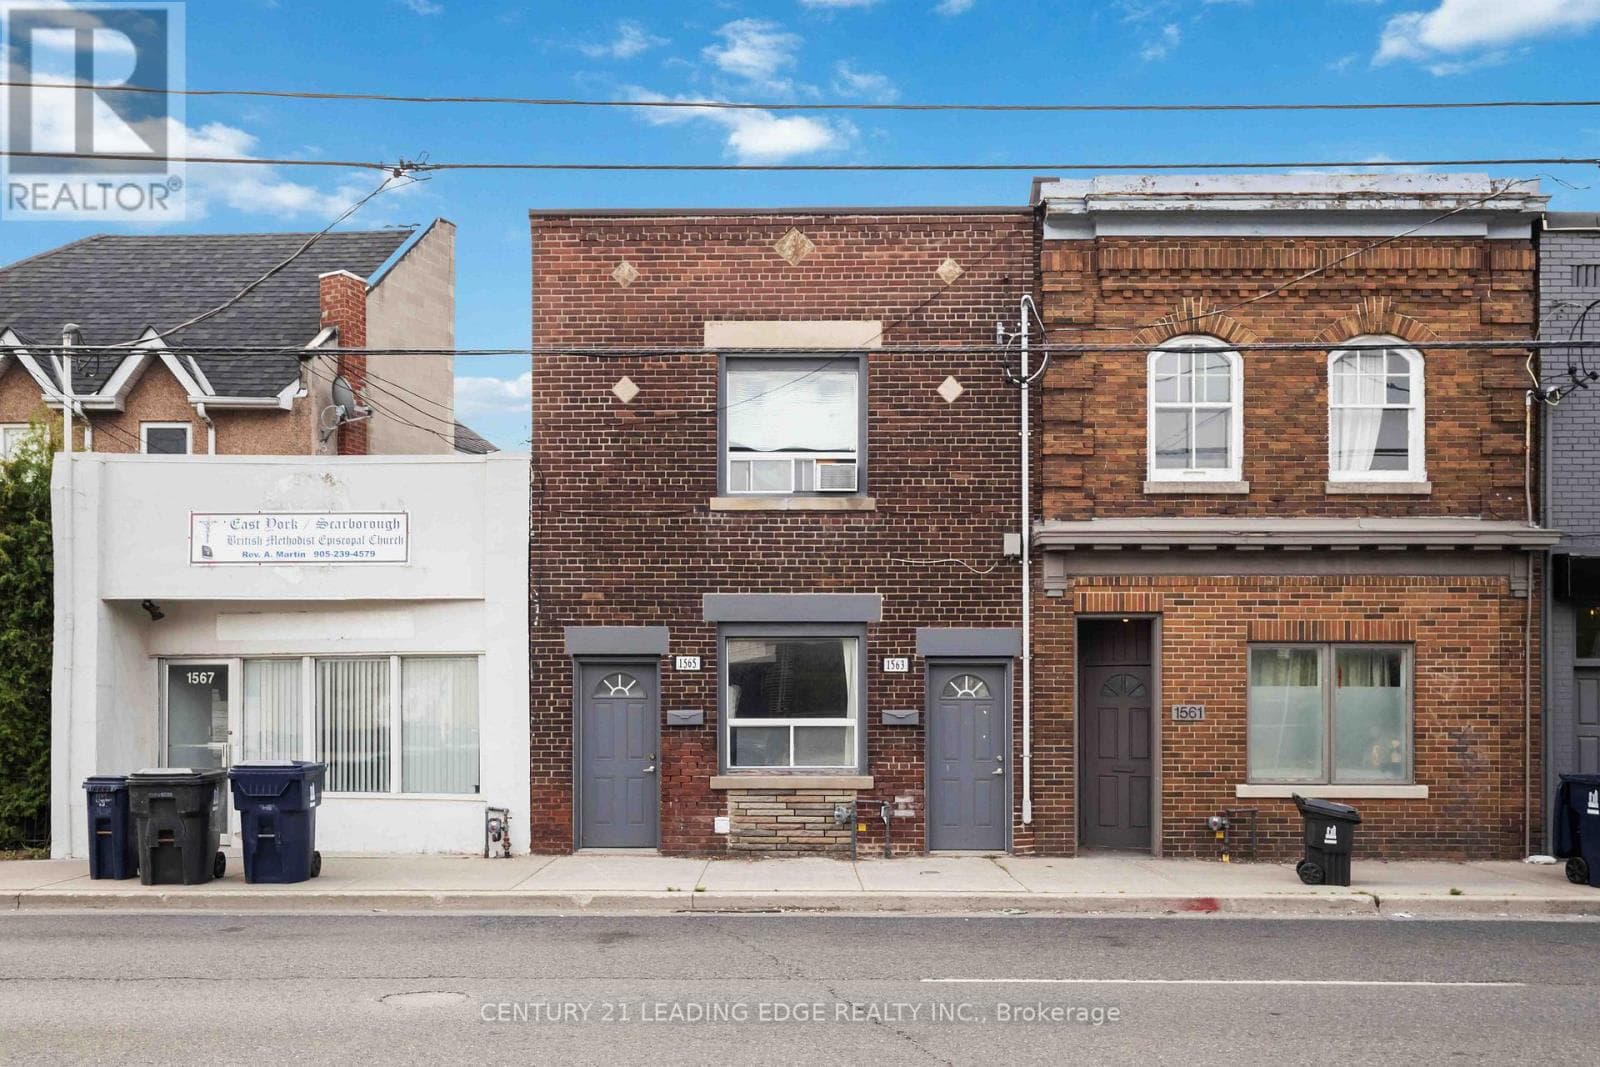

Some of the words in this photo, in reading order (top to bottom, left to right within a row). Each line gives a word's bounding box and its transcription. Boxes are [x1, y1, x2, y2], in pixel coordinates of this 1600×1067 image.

[229, 518, 260, 531] East
[265, 517, 298, 532] York
[315, 517, 400, 532] Scarborough
[226, 535, 262, 546] British
[265, 535, 315, 547] Methodist
[318, 534, 365, 547] Episcopal
[368, 534, 404, 546] Church
[276, 550, 306, 558] Martin
[313, 550, 376, 558] 905-239-4579
[678, 658, 697, 669] 1565
[886, 659, 905, 670] 1563
[186, 671, 215, 684] 1567
[1174, 706, 1202, 719] 1561
